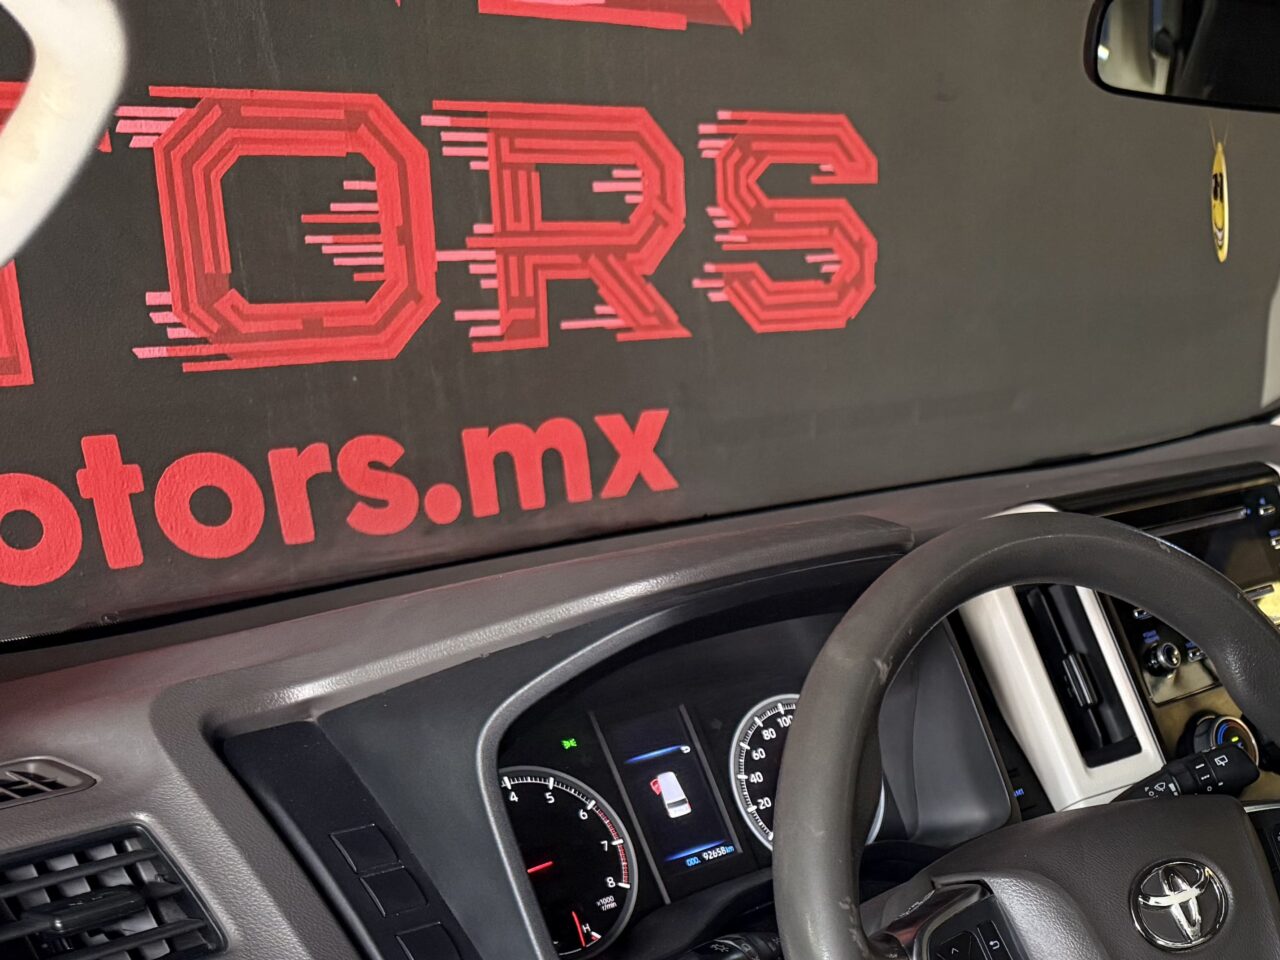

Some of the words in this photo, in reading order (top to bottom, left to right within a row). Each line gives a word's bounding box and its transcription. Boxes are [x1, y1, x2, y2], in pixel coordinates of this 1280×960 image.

[0, 408, 680, 587] otors.mx
[761, 727, 777, 741] 80
[751, 747, 766, 761] 60
[749, 771, 764, 784] 40
[508, 790, 519, 803] 4
[544, 791, 555, 804] 5
[756, 796, 772, 810] 20
[578, 808, 589, 821] 6
[600, 840, 609, 852] 7
[605, 876, 616, 888] 8
